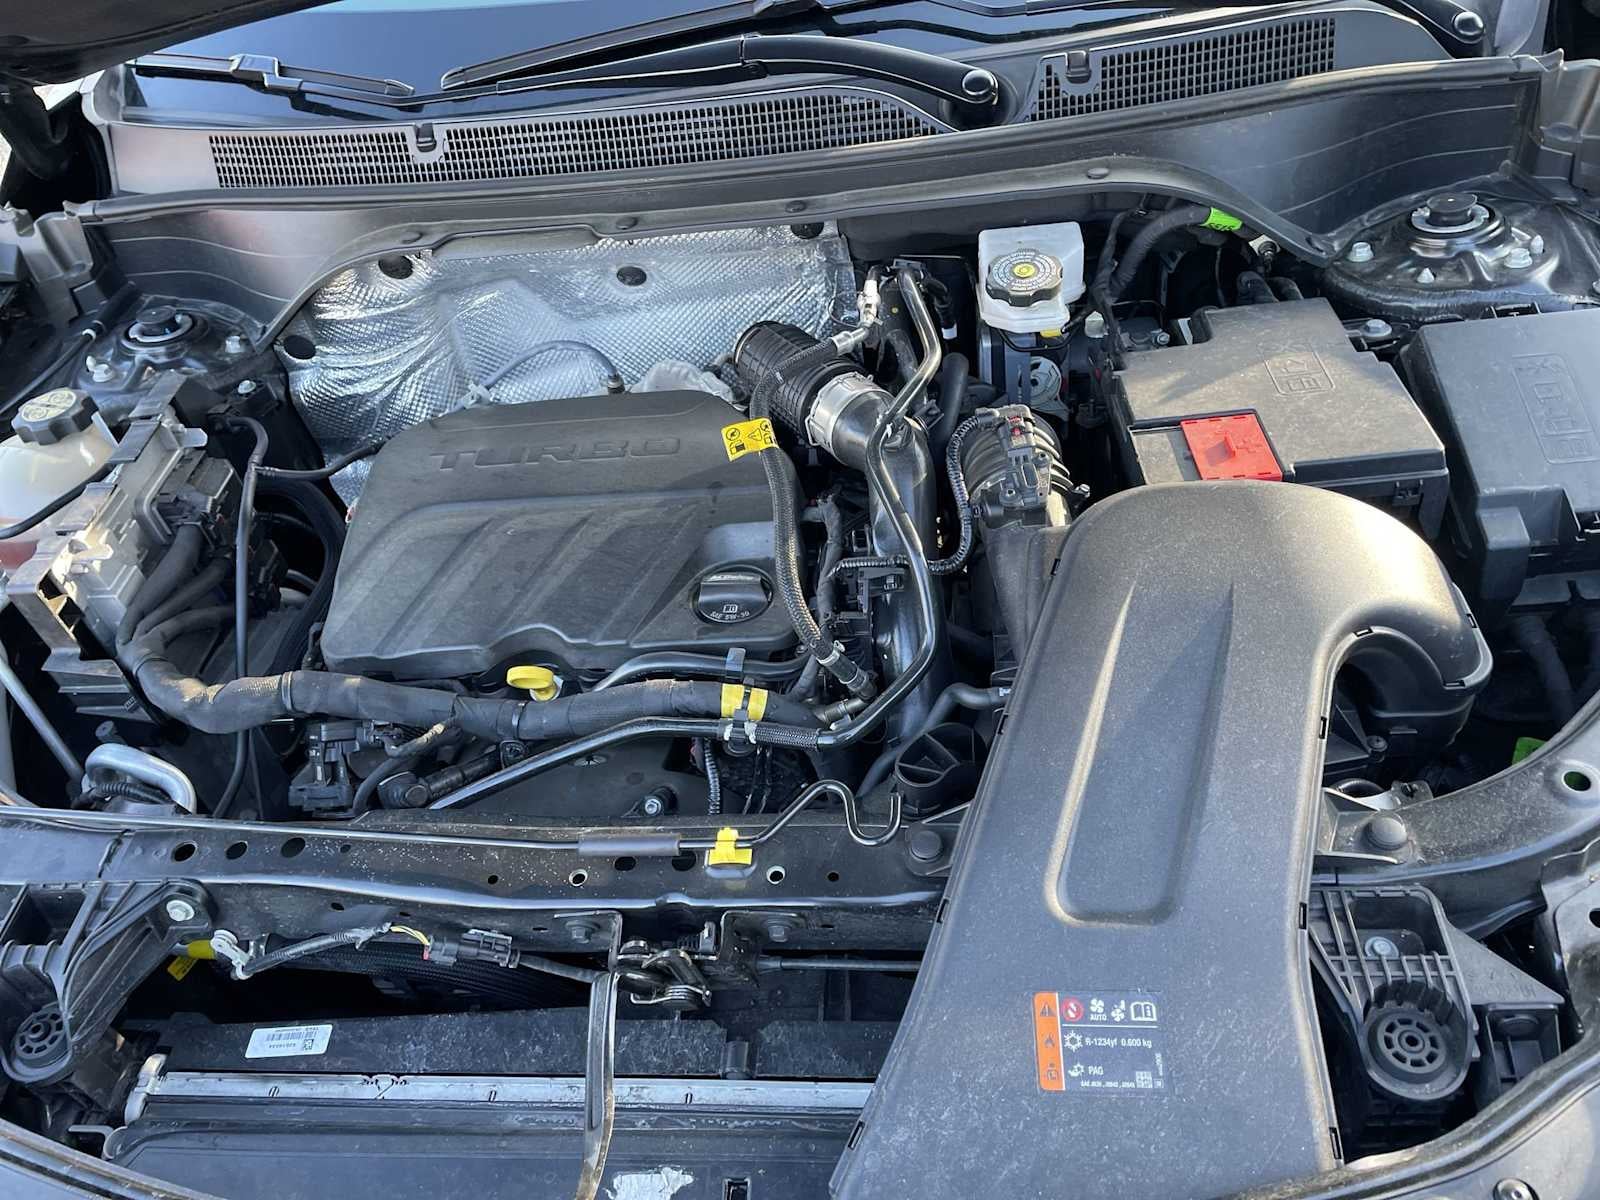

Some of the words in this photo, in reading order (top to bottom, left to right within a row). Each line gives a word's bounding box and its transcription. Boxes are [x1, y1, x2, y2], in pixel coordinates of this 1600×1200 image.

[429, 436, 681, 471] TURBO
[1089, 1013, 1108, 1022] AUTO
[1085, 1038, 1118, 1049] R-1234yf
[1142, 1038, 1153, 1049] kg
[1088, 1066, 1104, 1076] PAG
